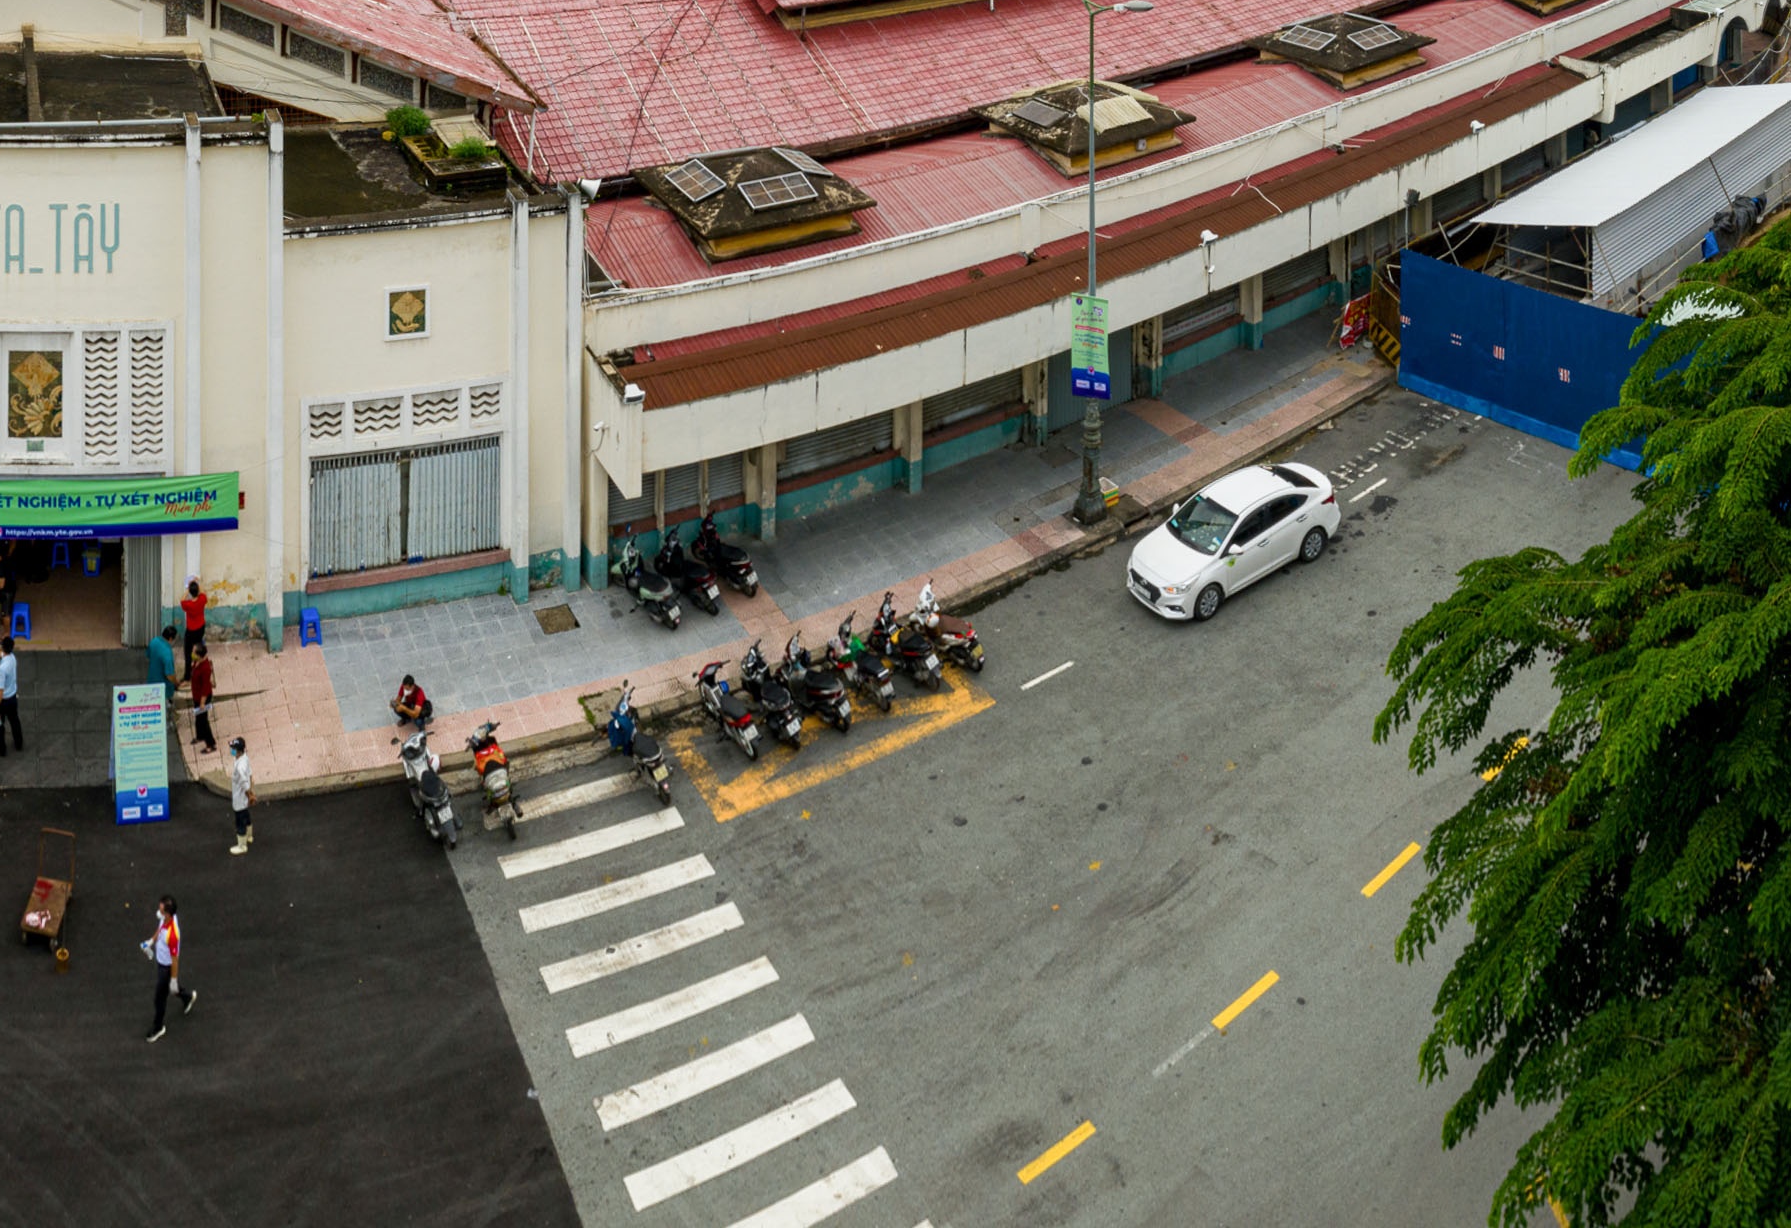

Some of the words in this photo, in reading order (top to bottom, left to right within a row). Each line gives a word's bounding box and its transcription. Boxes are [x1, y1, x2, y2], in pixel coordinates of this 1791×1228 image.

[18, 494, 81, 511] NGHIỆM
[95, 494, 115, 510] TỰ
[120, 491, 149, 507] XÉT
[154, 487, 217, 505] NGHIỆM
